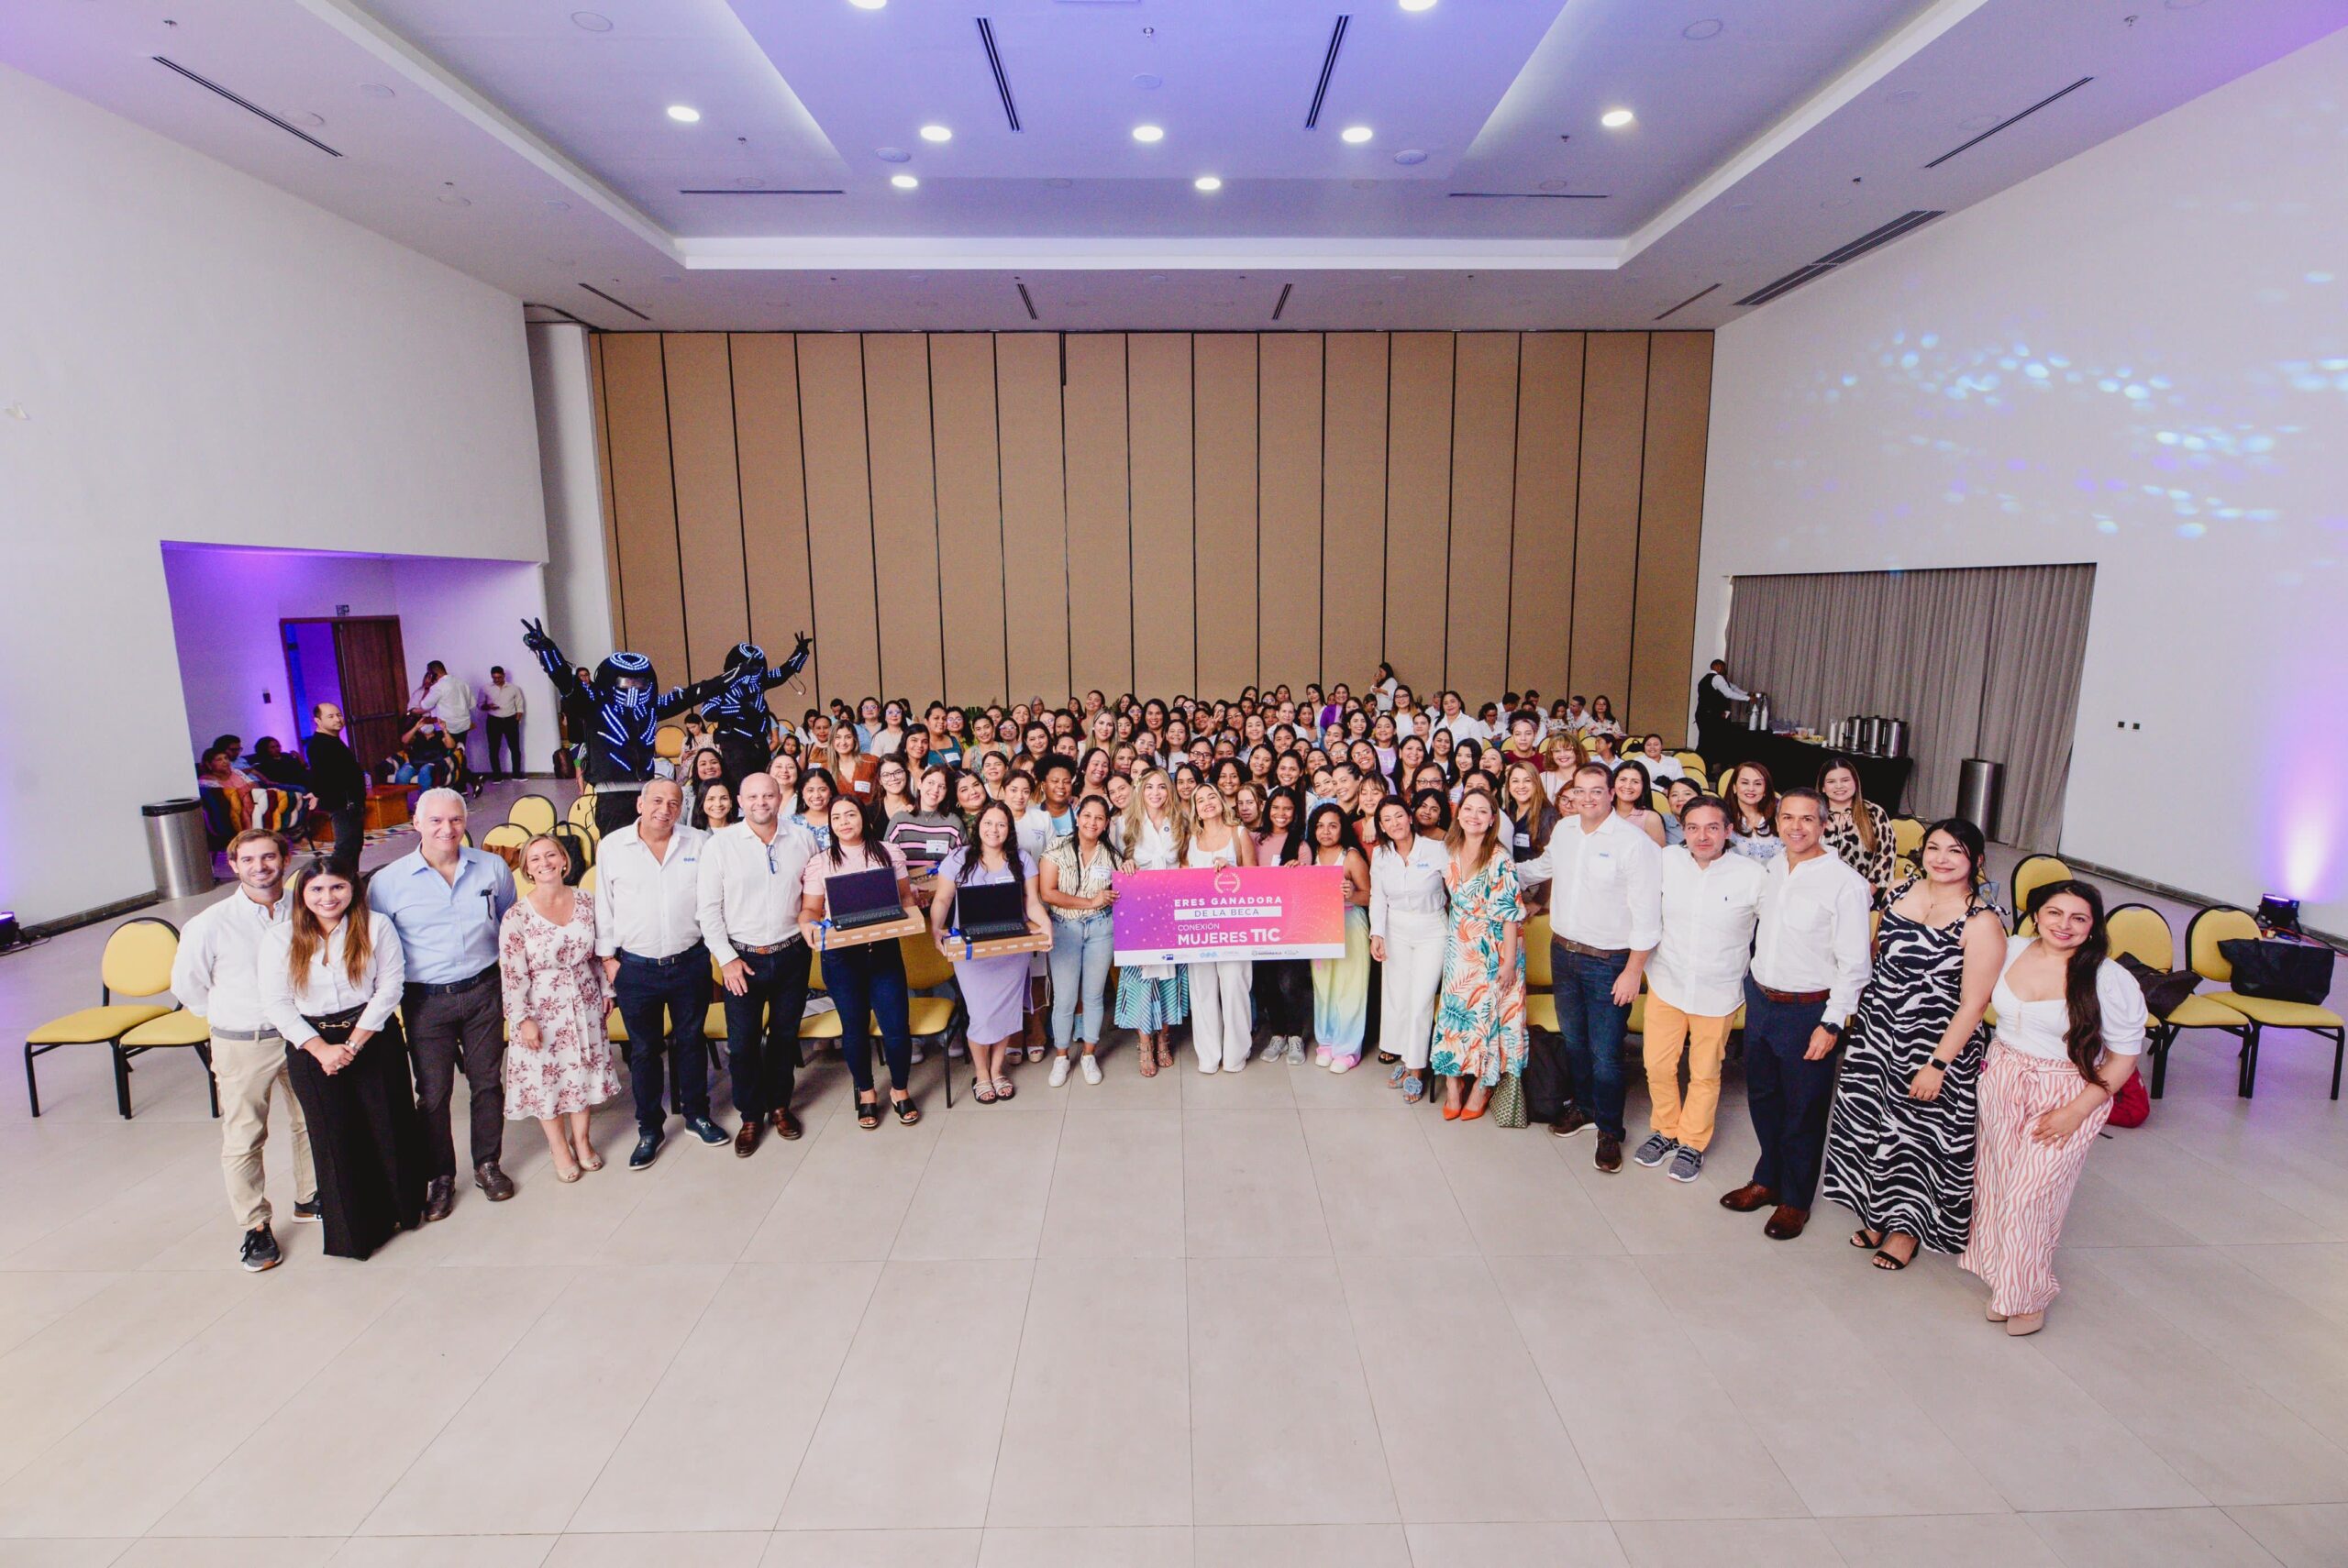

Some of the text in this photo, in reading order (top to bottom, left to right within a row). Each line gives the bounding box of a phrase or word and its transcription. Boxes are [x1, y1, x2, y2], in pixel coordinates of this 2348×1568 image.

[1174, 896, 1282, 907] ERES GANADORA
[1194, 908, 1259, 918] DE LA BECA
[1178, 922, 1220, 932] CONEXIÓN
[1178, 928, 1280, 945] MUJERES TIC
